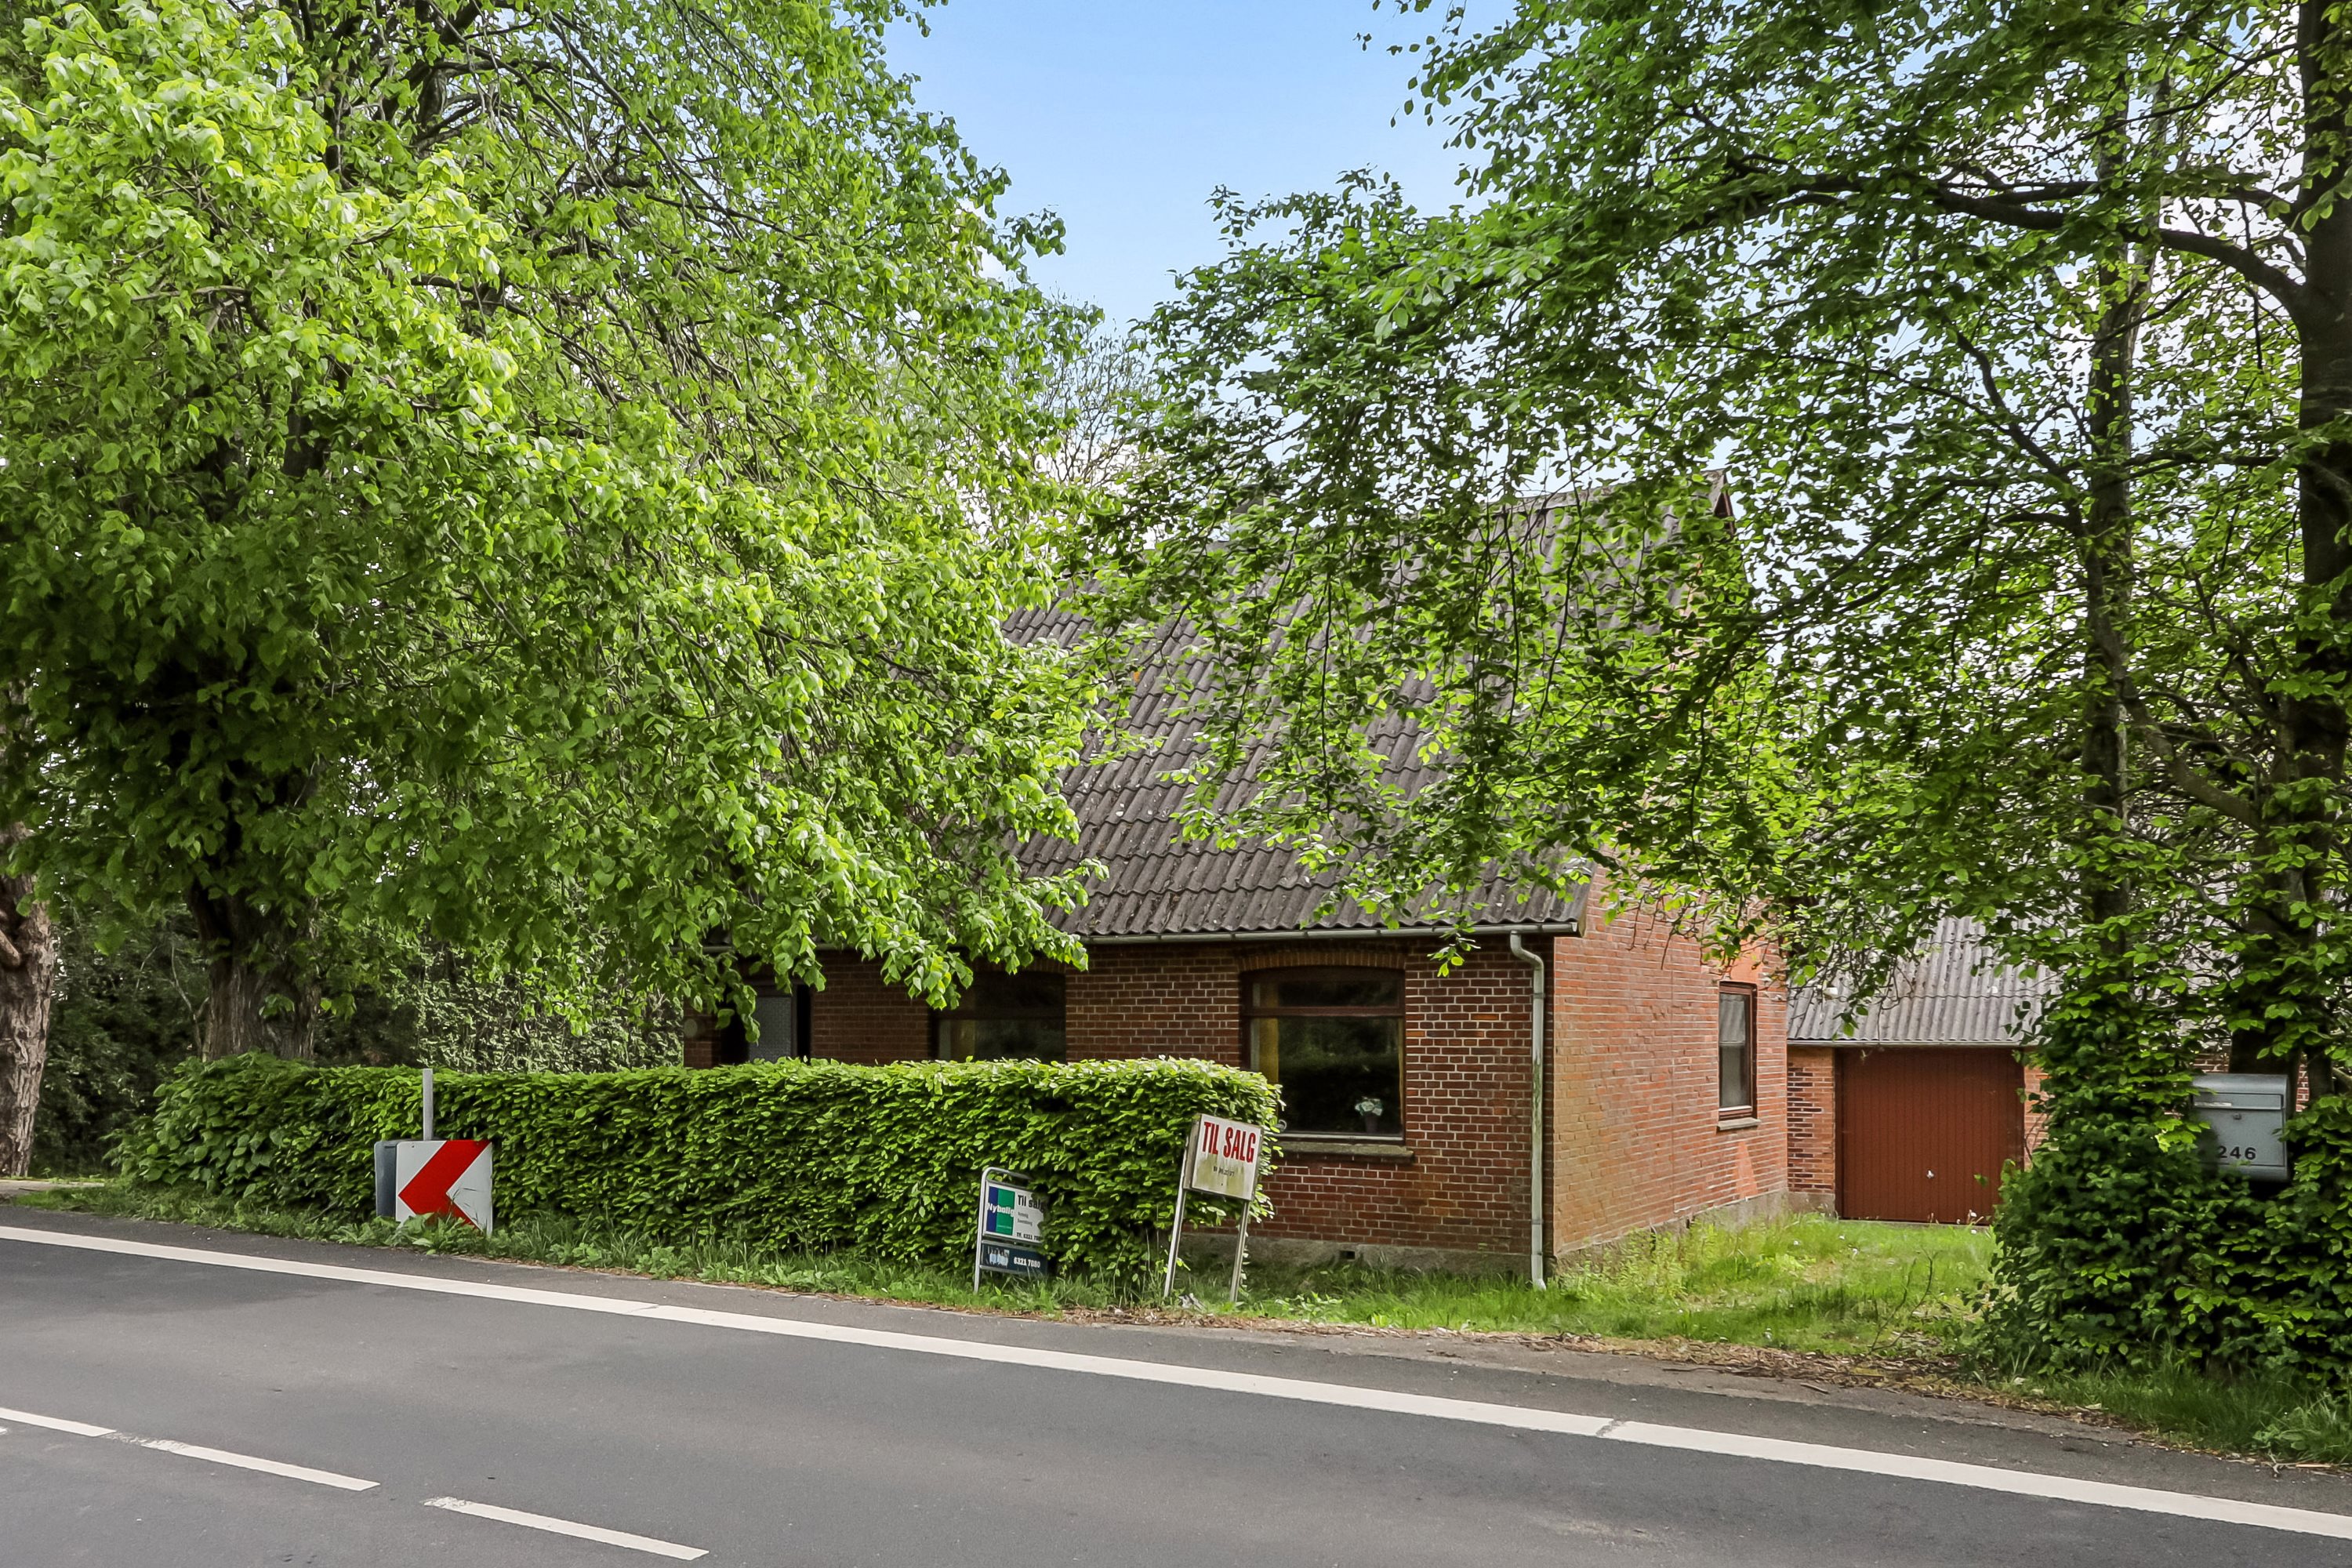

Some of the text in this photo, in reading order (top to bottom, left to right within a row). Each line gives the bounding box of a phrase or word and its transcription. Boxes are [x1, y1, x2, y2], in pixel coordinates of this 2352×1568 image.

[1202, 1121, 1256, 1163] TIL SALG
[2218, 1145, 2256, 1160] 246
[1018, 1195, 1026, 1207] Til
[987, 1203, 1014, 1217] Nybolig
[1014, 1257, 1026, 1265] 6321
